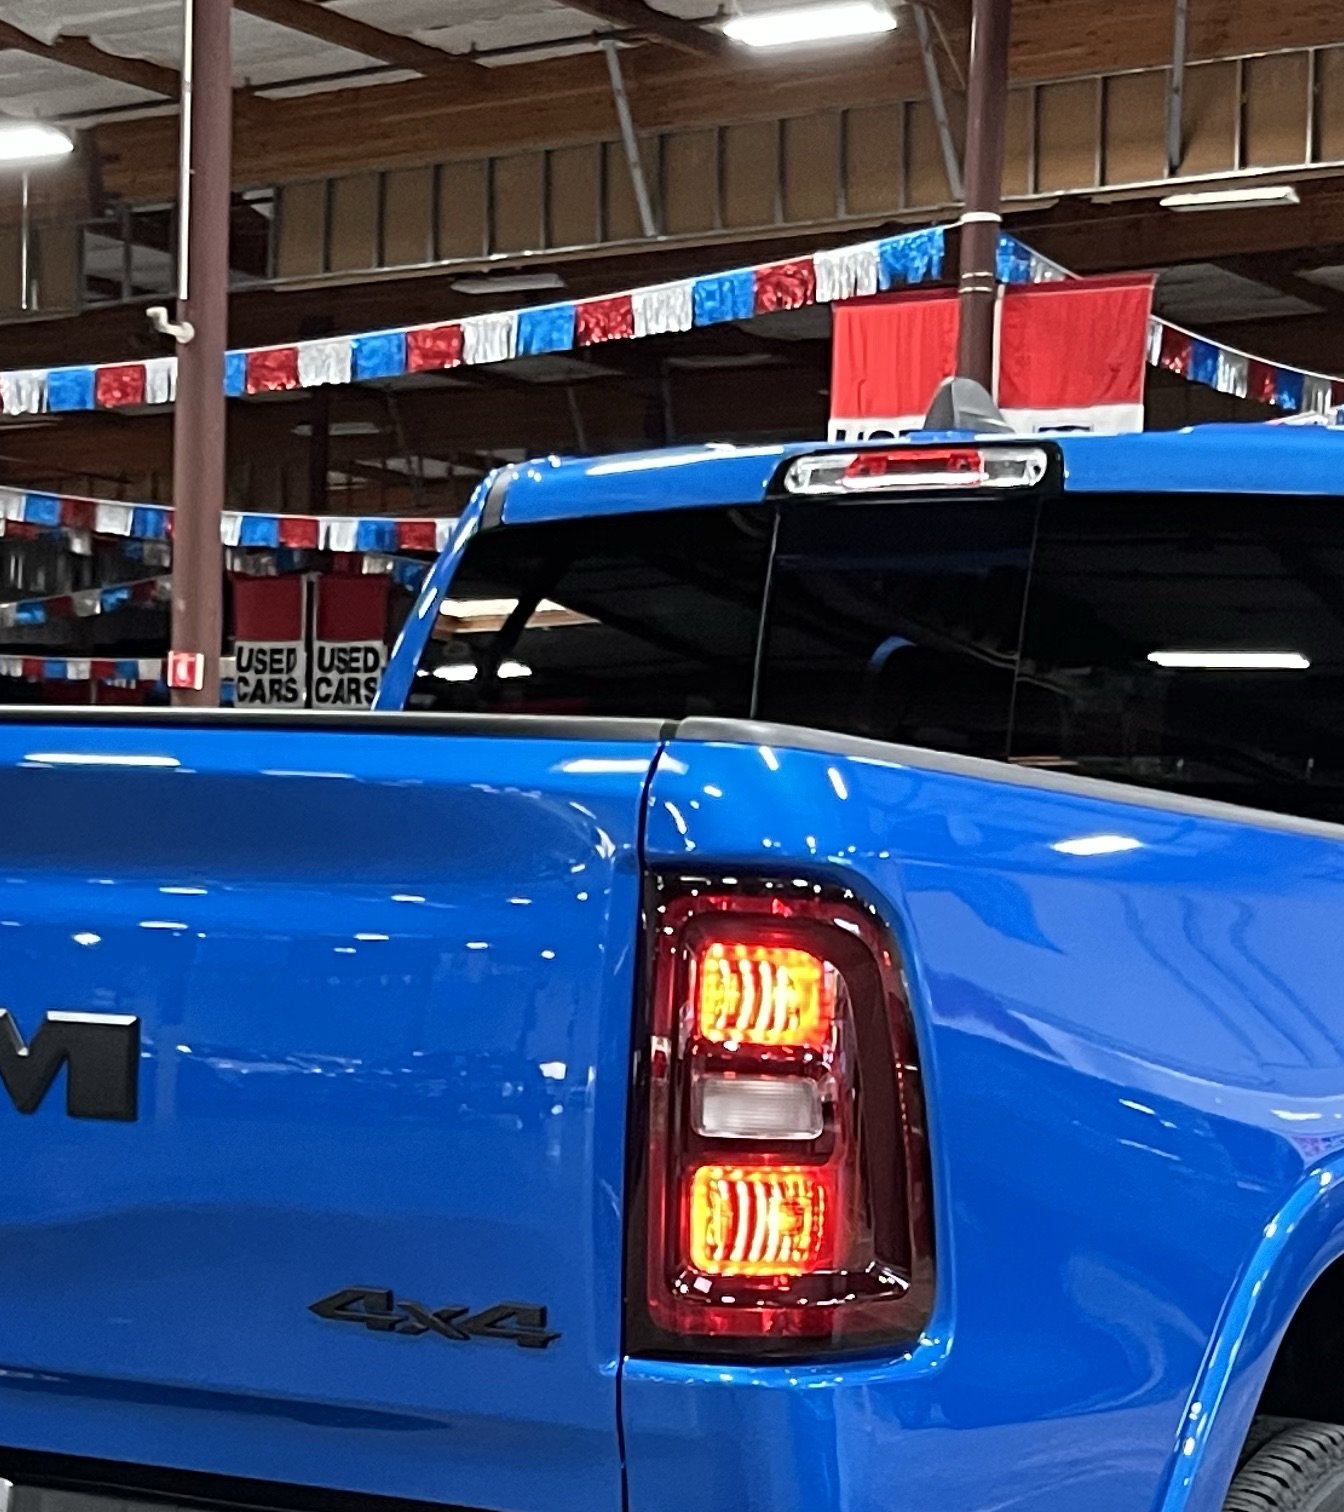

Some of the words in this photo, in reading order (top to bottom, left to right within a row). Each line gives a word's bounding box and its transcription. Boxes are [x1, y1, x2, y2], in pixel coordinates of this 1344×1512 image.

[236, 646, 297, 675] USED
[317, 646, 380, 674] USED
[236, 676, 299, 703] CARS
[314, 677, 379, 705] CARS
[308, 1286, 562, 1349] 4x4
